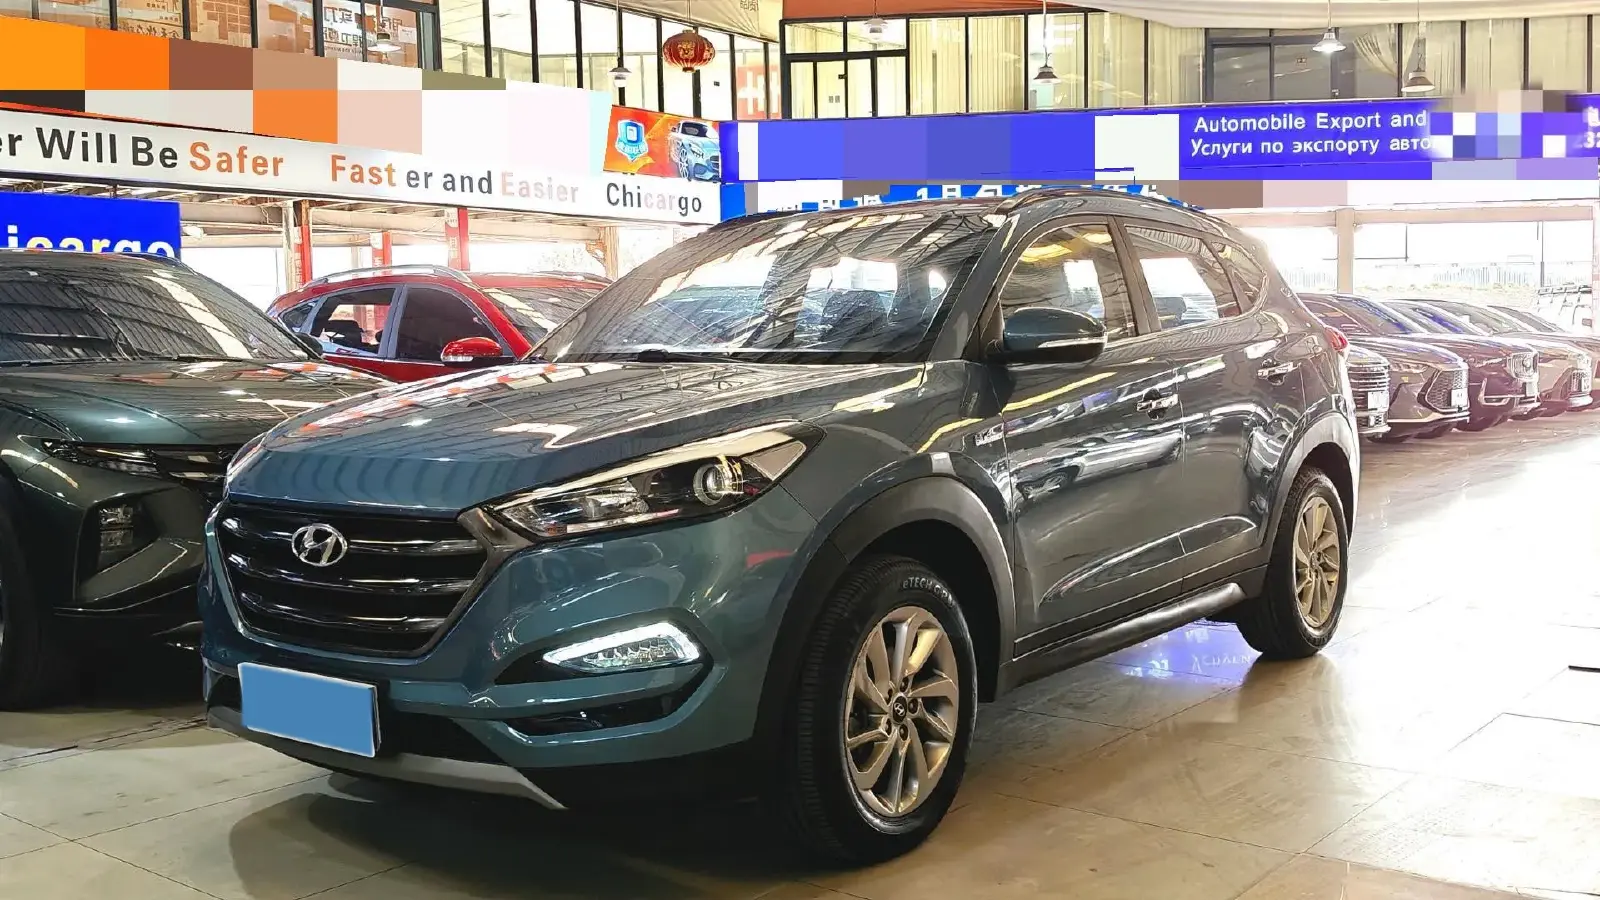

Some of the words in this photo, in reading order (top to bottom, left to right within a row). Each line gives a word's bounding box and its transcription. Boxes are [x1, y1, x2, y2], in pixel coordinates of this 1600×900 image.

[1194, 114, 1306, 132] Automobile
[1316, 112, 1381, 131] Export
[1391, 110, 1427, 127] and
[1191, 138, 1252, 158] Услуги
[1261, 139, 1283, 153] по
[1292, 137, 1380, 155] экспорту
[36, 127, 117, 163] Will
[132, 136, 178, 168] Be
[189, 142, 284, 176] Safer
[443, 170, 492, 194] and
[501, 172, 579, 203] Easier
[606, 182, 702, 217] Chicargo
